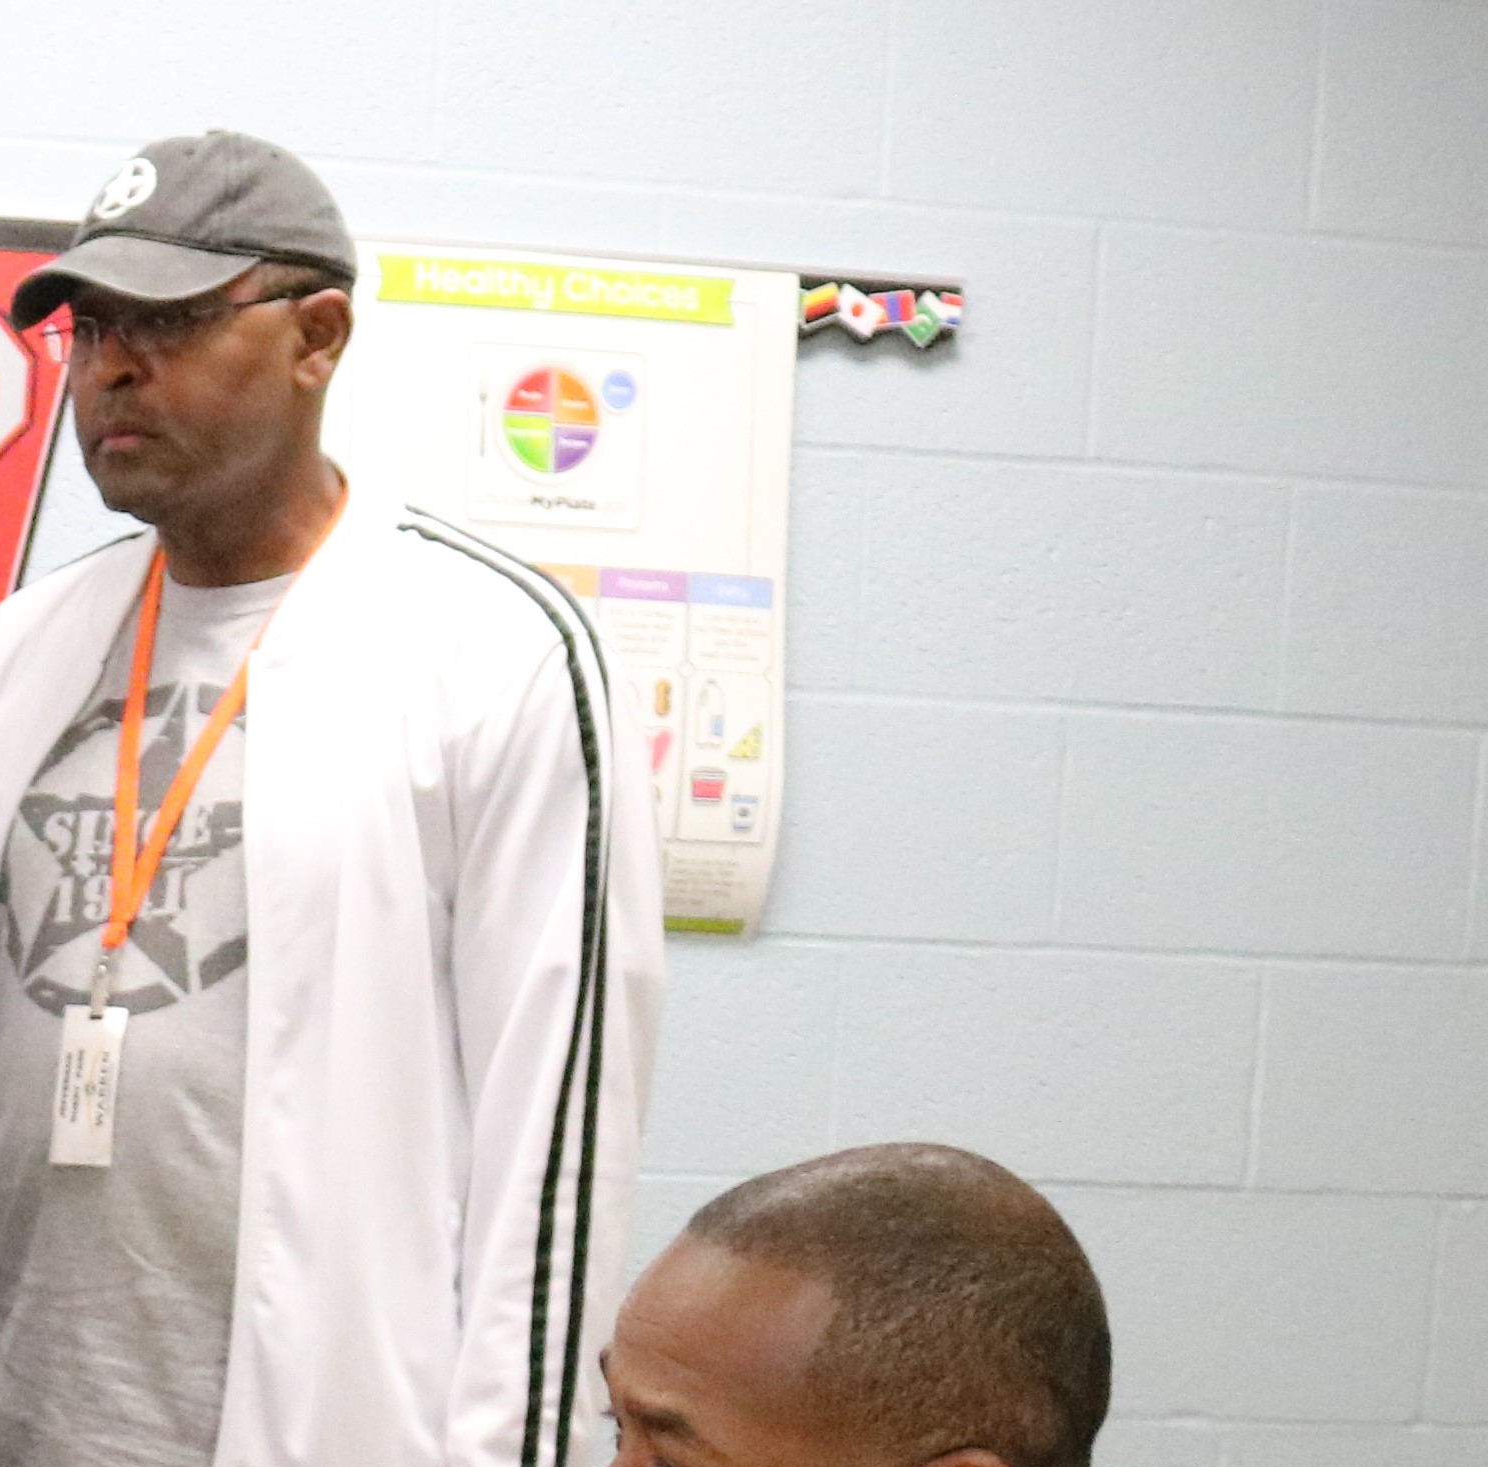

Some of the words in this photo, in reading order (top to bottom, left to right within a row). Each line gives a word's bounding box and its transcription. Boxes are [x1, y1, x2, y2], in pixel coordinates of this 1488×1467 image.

[415, 262, 556, 309] Healthy
[564, 271, 700, 312] Choices
[52, 868, 184, 923] 191
